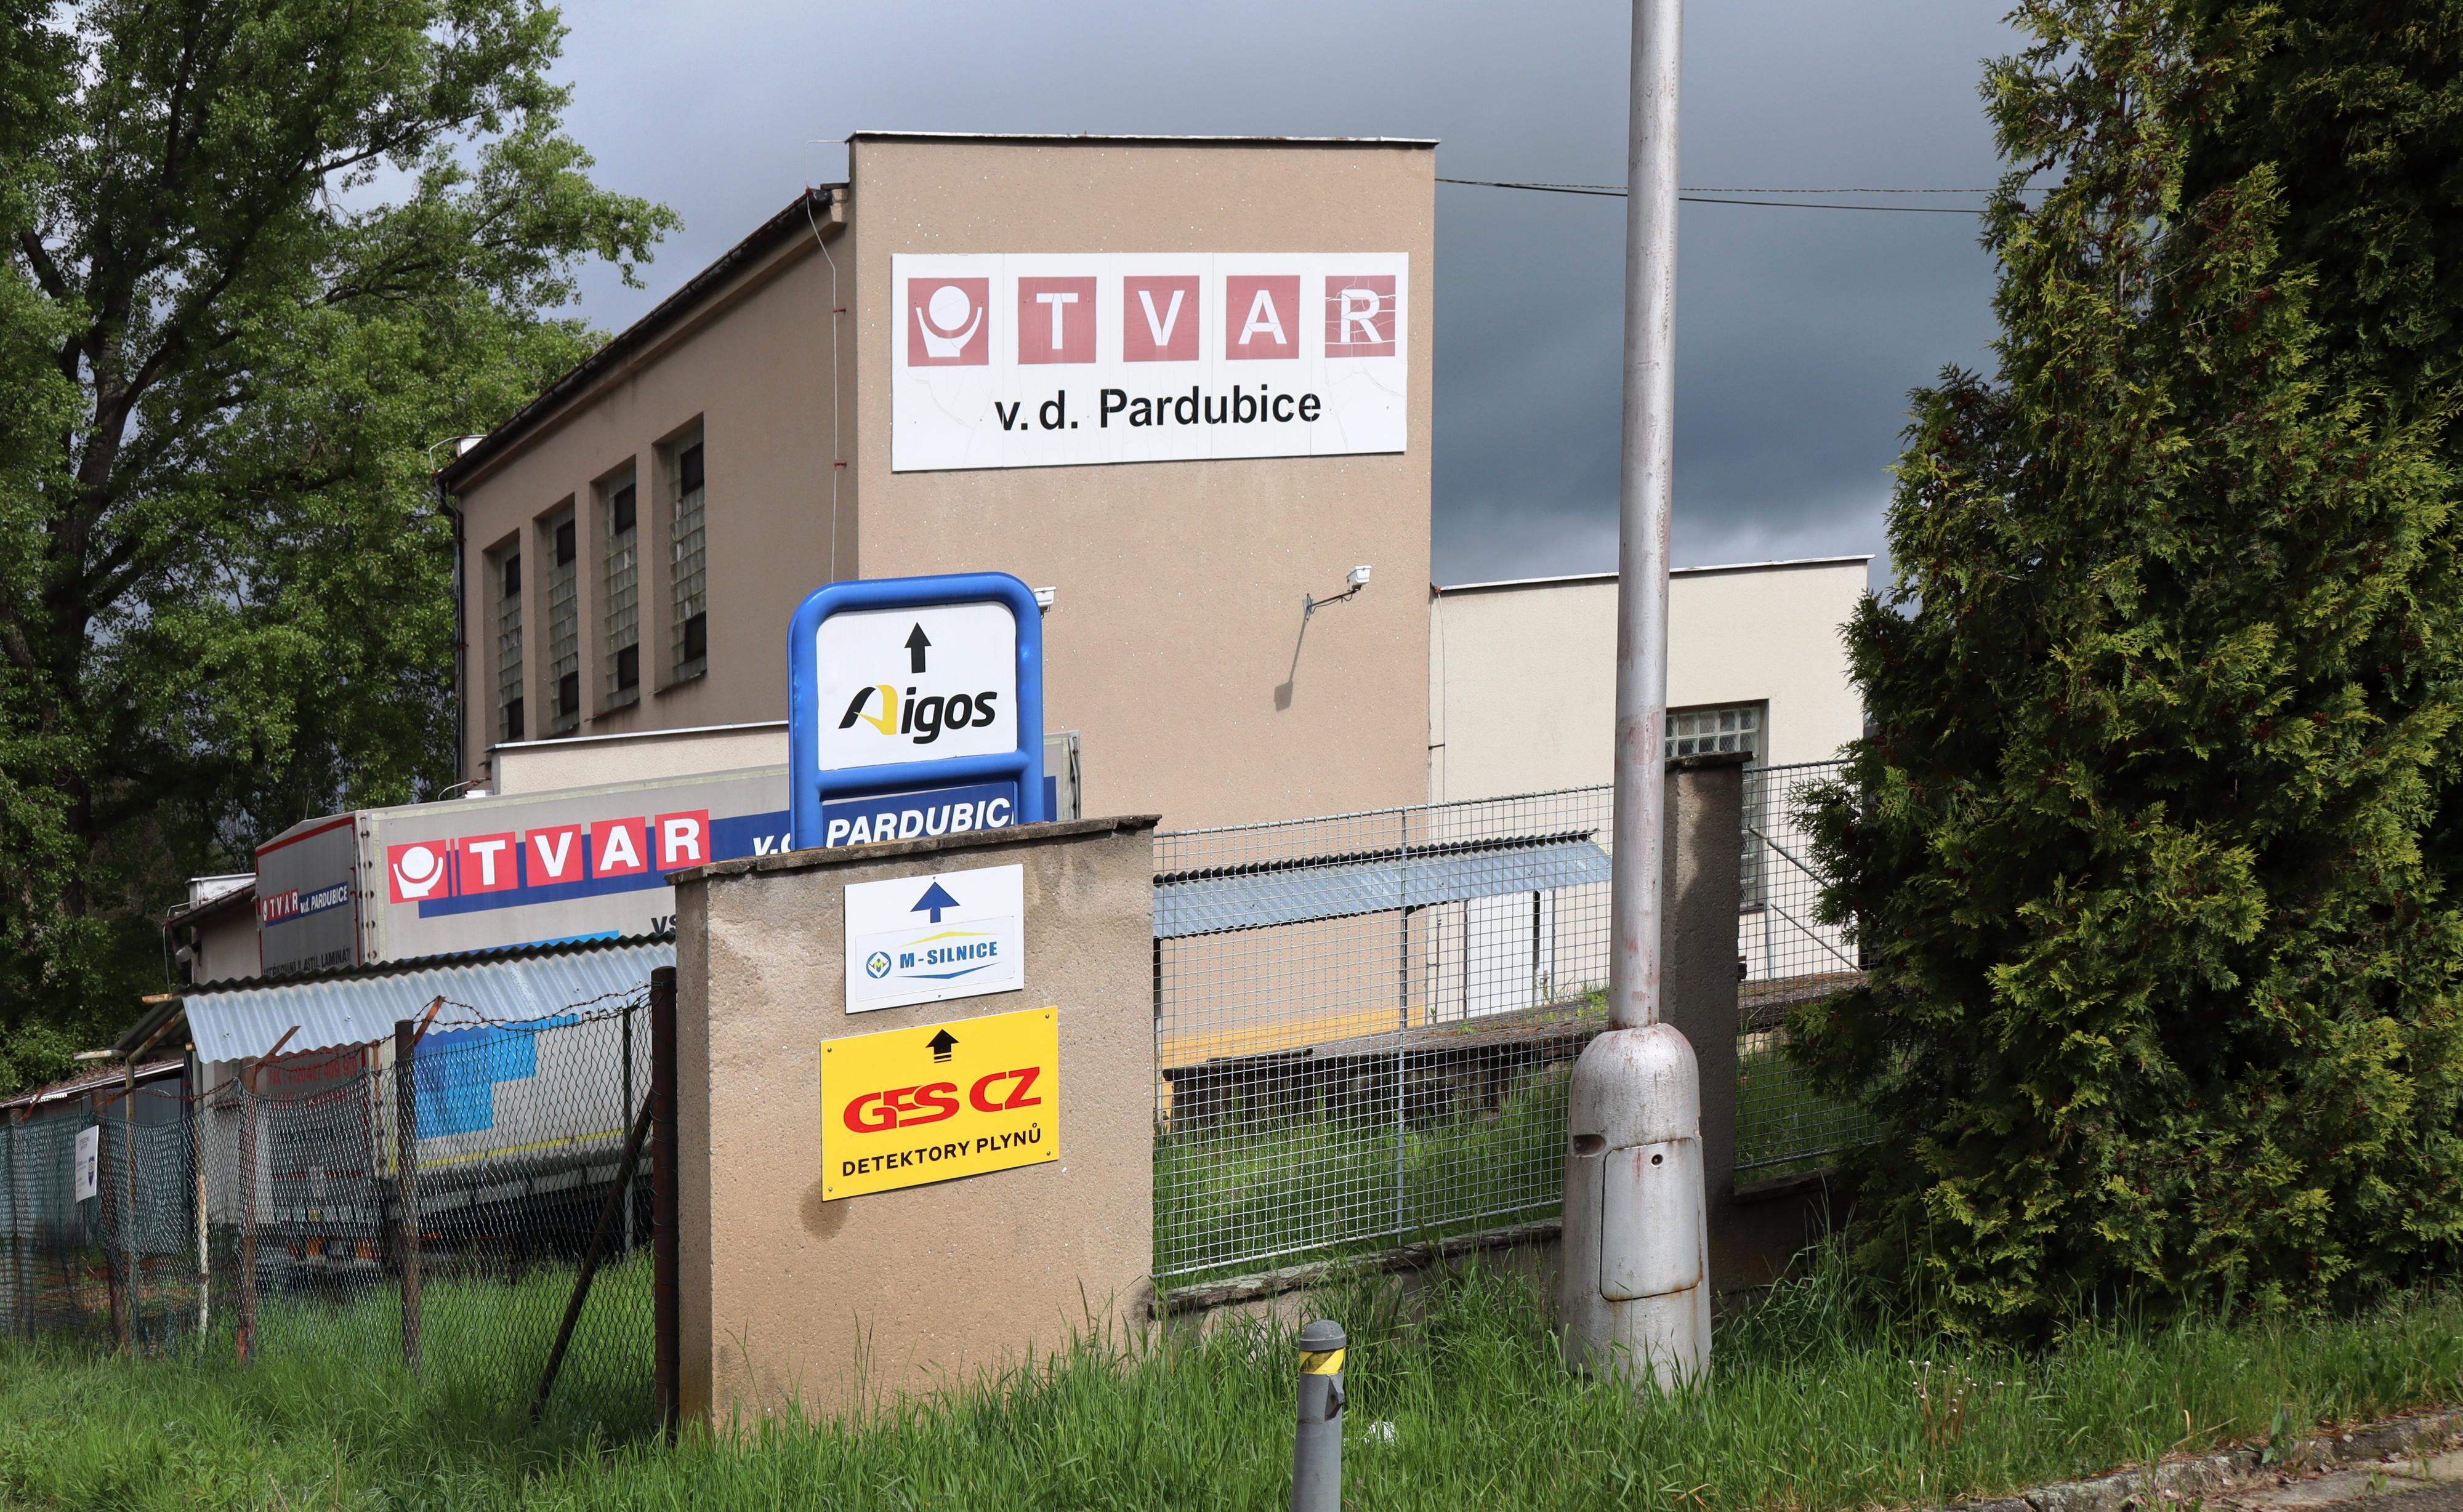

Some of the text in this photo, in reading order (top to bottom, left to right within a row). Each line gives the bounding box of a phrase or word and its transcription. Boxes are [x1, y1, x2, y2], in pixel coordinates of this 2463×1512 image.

[1036, 289, 1384, 350] TVAR
[994, 384, 1321, 430] v. d. Pardubice
[838, 685, 998, 744] Aigos
[468, 818, 701, 886] TVAR
[826, 797, 1015, 848] PARDUBIC
[270, 891, 299, 917] TVAR
[310, 885, 348, 911] PARDUBICE
[843, 1066, 1041, 1133] GES CZ
[842, 1122, 1041, 1176] DETEKTORY PLYNŮ
